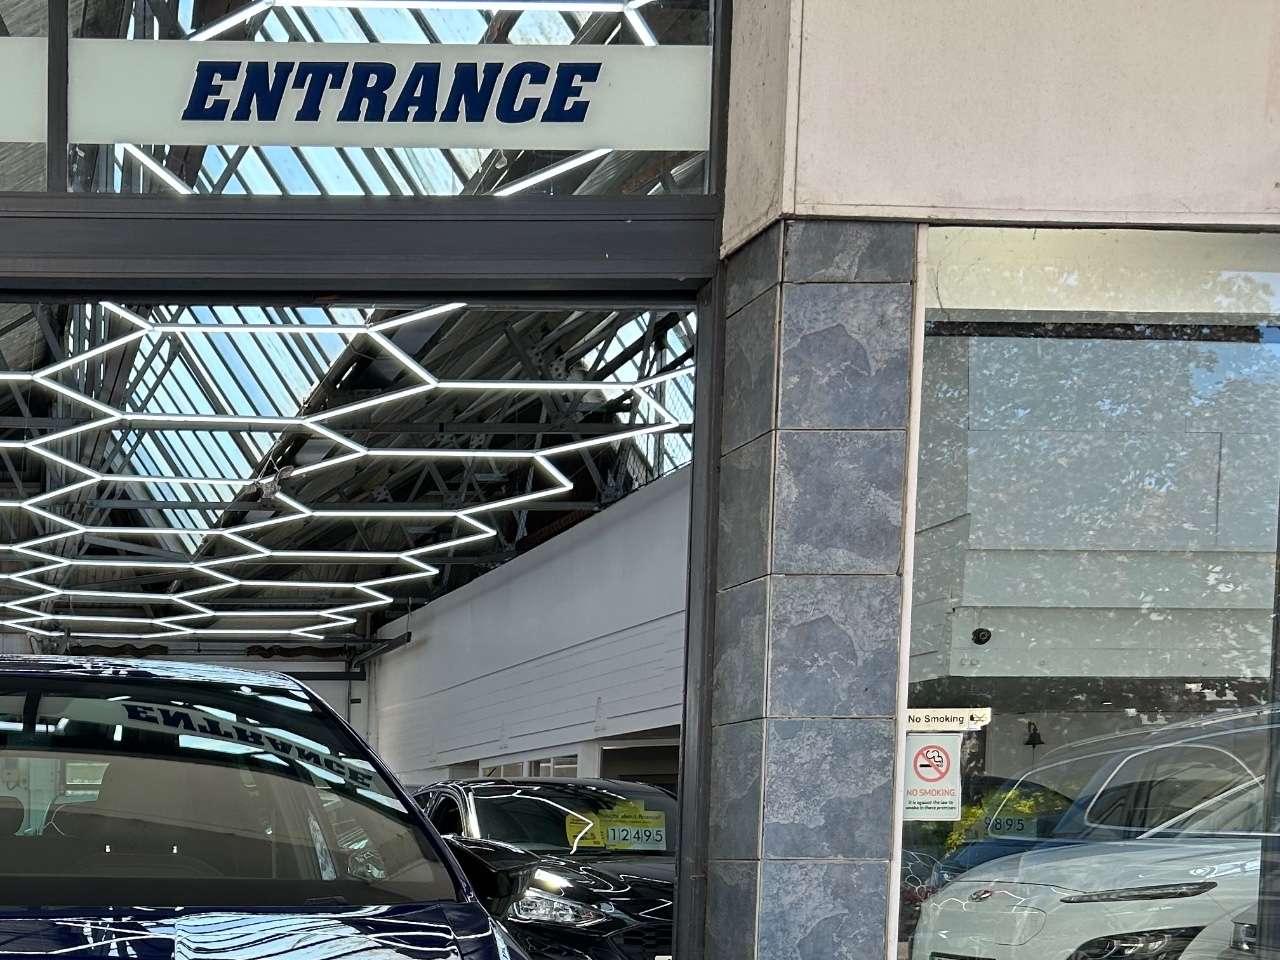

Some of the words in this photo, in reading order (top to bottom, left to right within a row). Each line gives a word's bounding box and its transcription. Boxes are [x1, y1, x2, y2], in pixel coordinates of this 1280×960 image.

[181, 60, 602, 123] ENTRANCE
[908, 715, 922, 723] No
[924, 714, 965, 725] Smoking
[906, 788, 918, 797] NO
[918, 788, 956, 797] SMOKING
[609, 828, 663, 842] 12495
